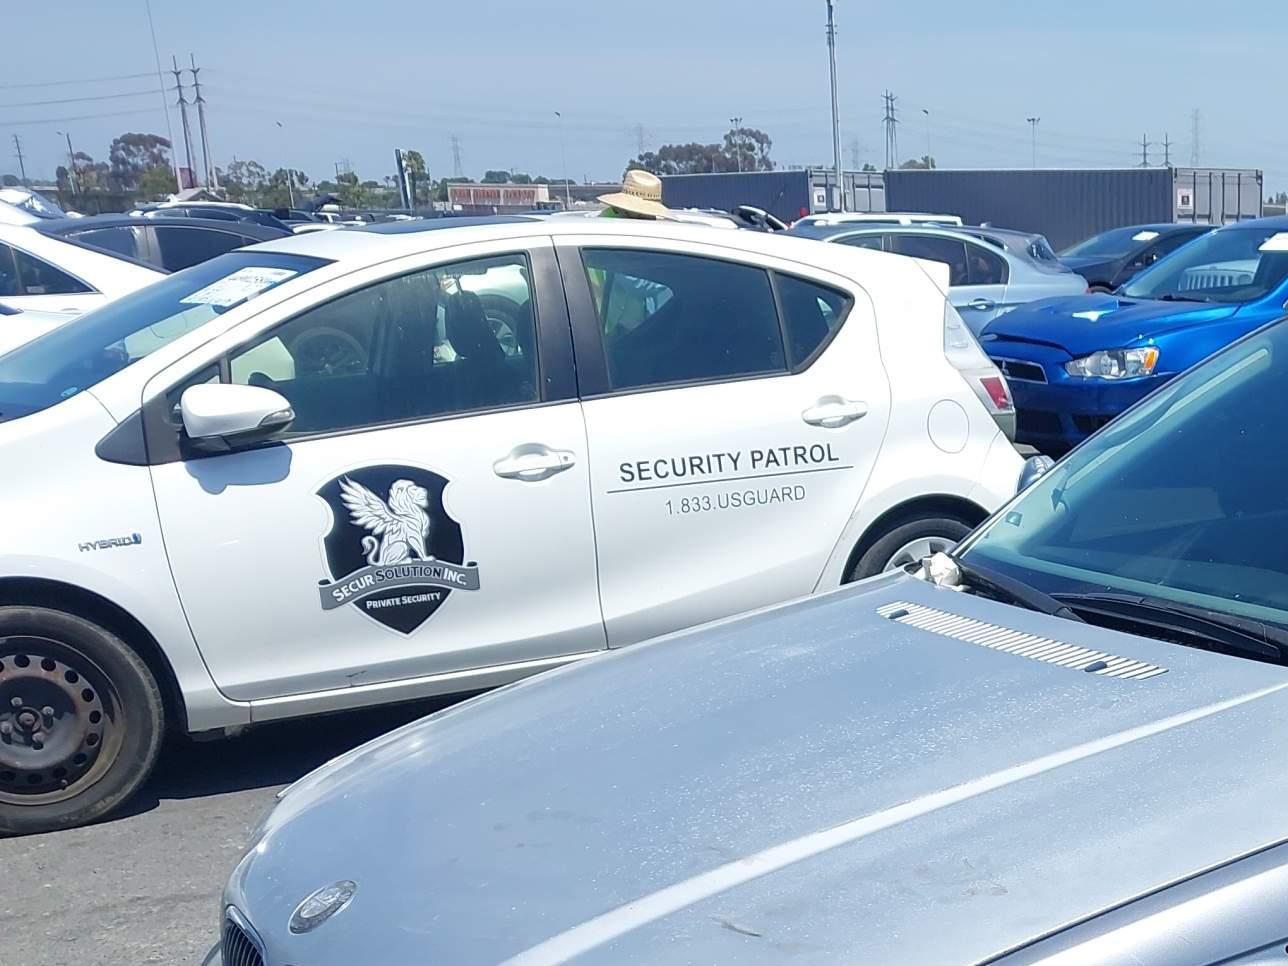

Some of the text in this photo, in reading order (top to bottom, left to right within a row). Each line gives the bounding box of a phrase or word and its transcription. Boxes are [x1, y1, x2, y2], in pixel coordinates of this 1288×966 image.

[619, 443, 840, 483] SECURITY PATROL
[665, 485, 807, 516] 1.833.USGUARD
[78, 536, 132, 552] HYBRID
[332, 566, 467, 602] SECUR SOLUTION INC.
[366, 592, 441, 609] PRIVATE SECURITY
